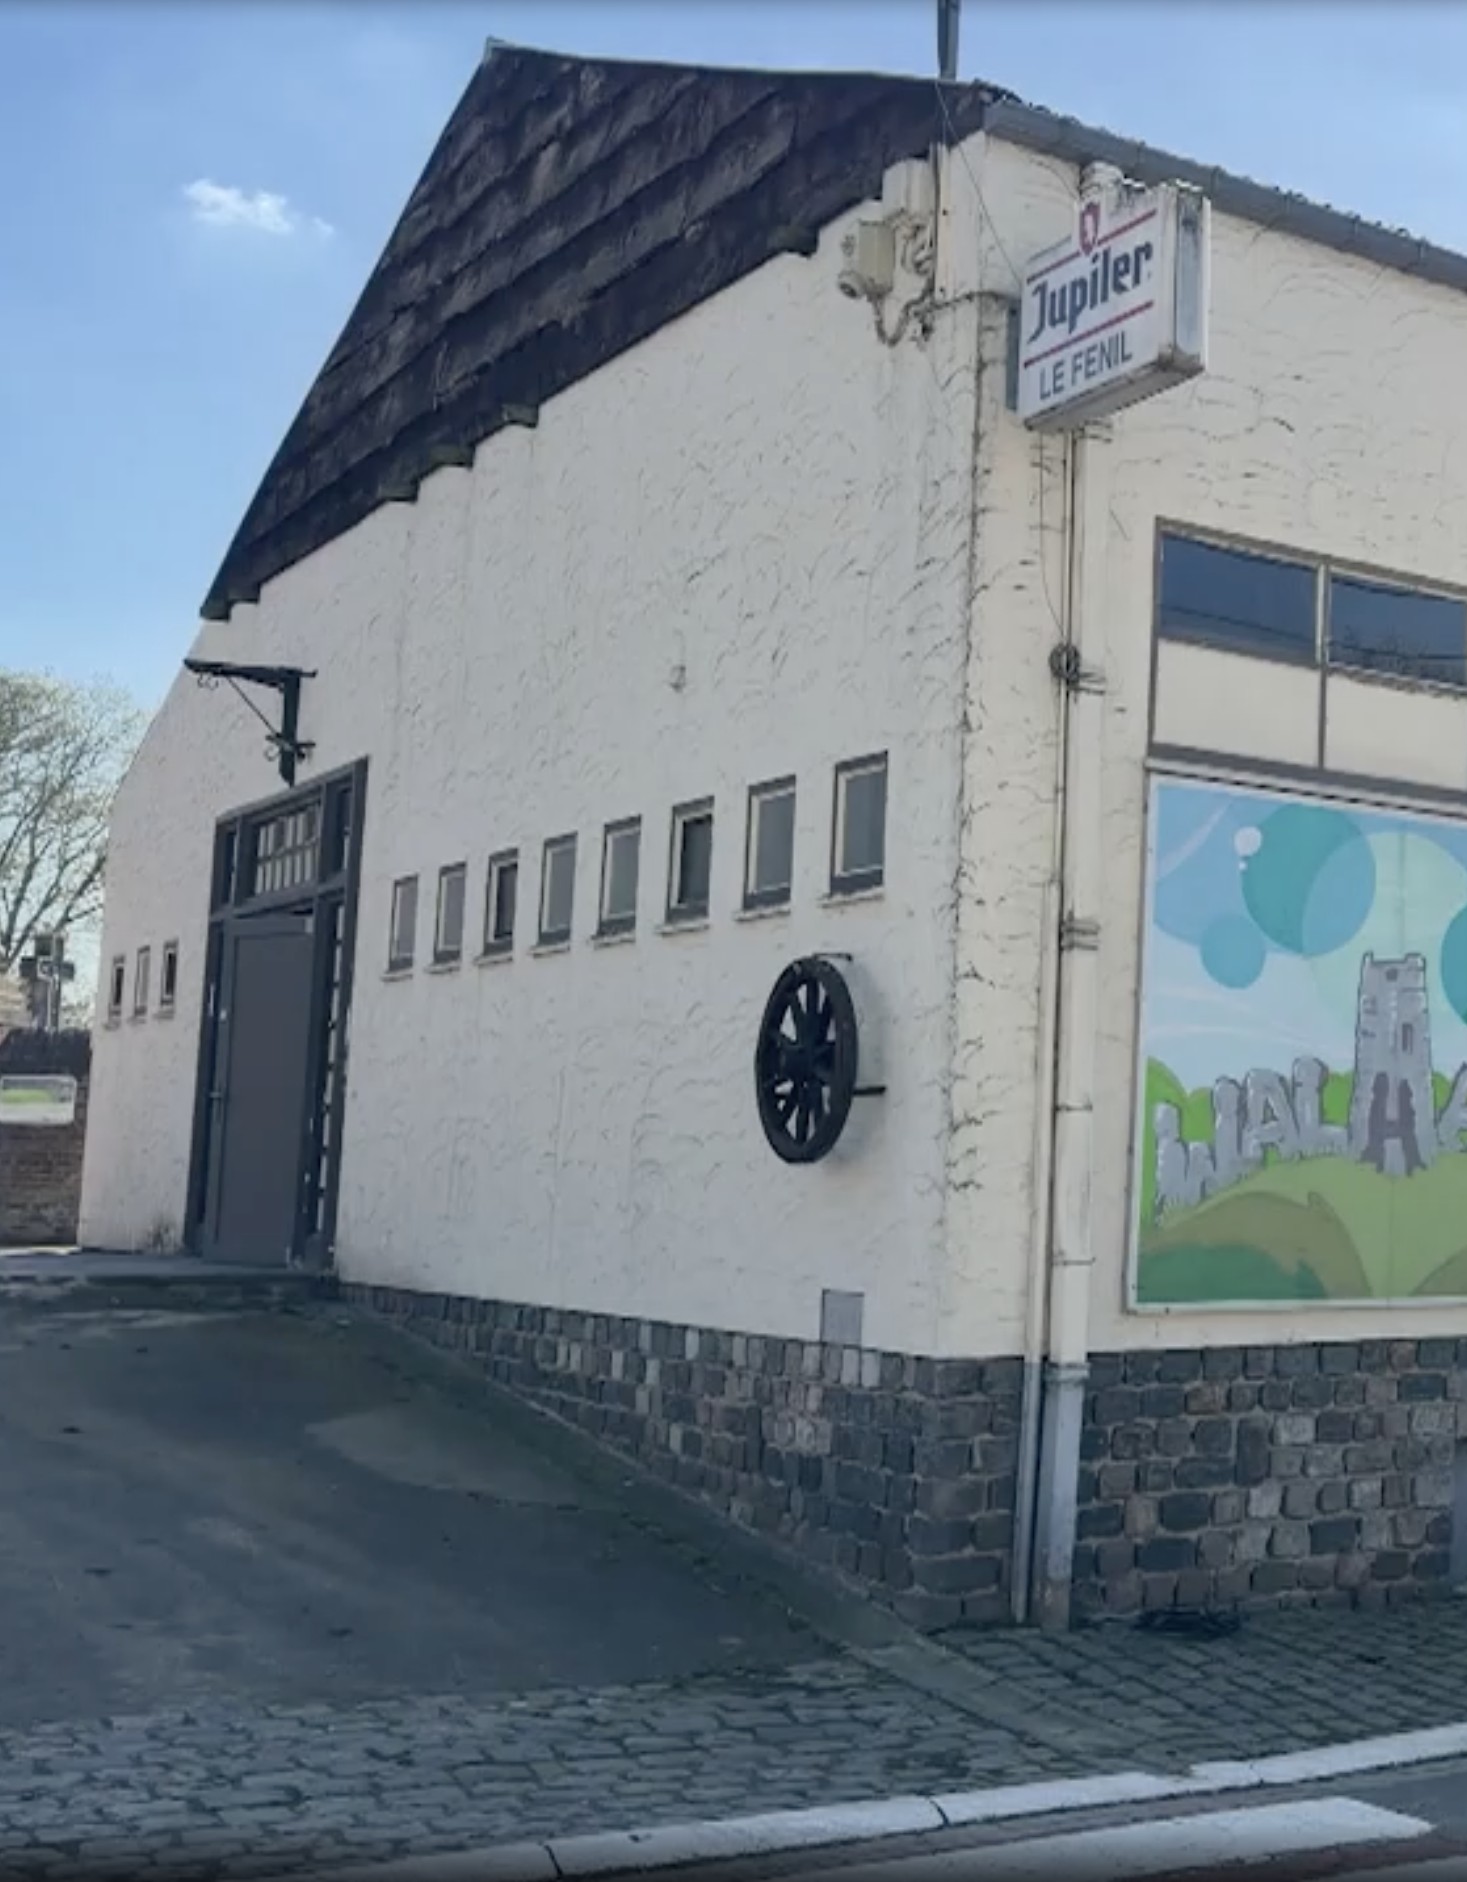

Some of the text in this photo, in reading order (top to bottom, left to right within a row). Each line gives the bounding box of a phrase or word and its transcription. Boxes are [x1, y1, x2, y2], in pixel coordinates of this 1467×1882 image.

[1027, 241, 1154, 345] Jupiler
[1039, 331, 1133, 400] LE FENIL
